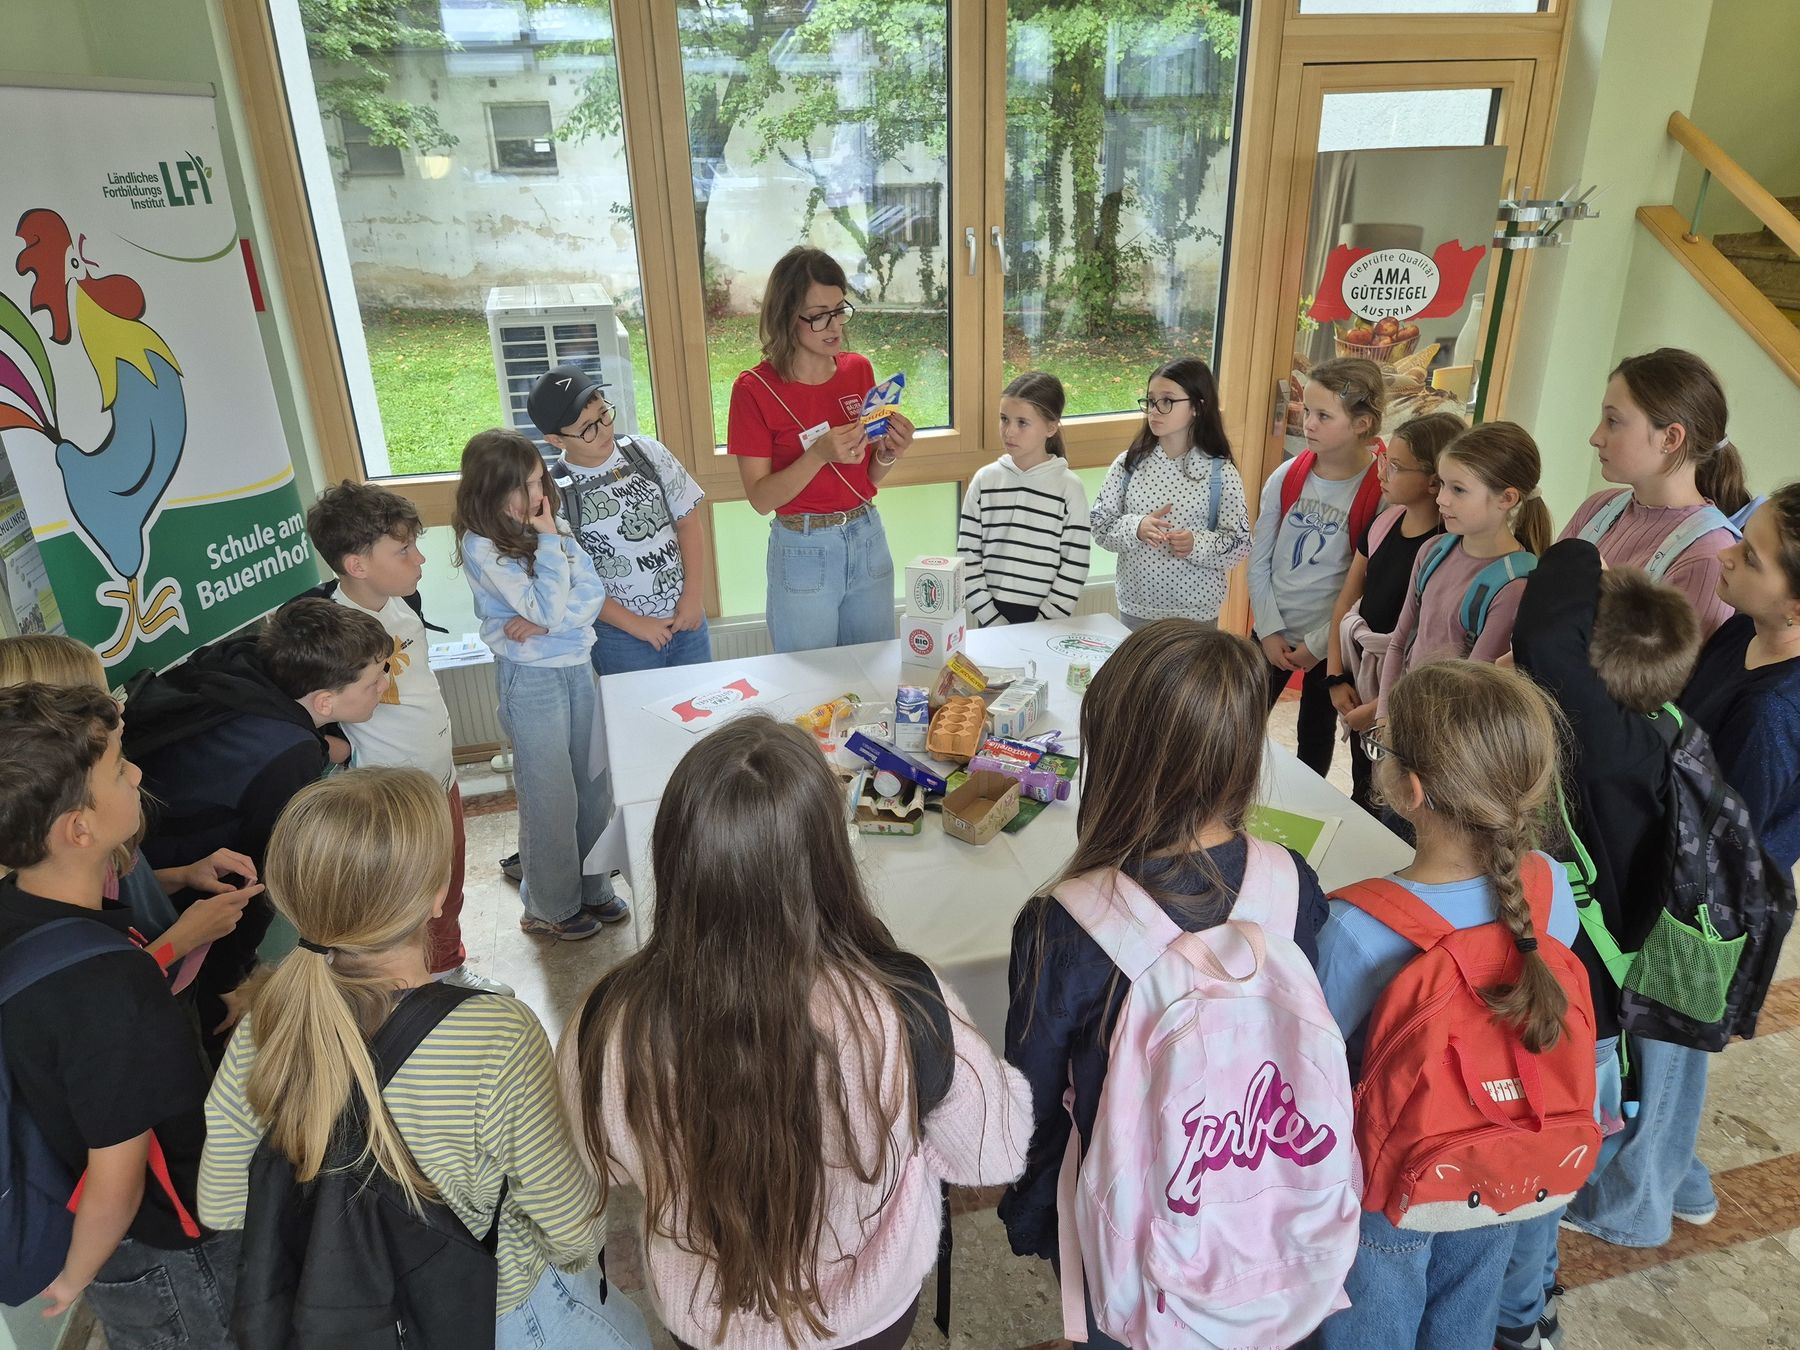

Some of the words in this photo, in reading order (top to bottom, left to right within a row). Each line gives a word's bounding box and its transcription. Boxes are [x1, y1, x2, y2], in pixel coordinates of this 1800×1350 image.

[106, 171, 160, 185] Ländliches
[158, 150, 213, 207] LFI
[102, 185, 163, 198] Fortbildungs
[130, 198, 166, 210] Institut
[1349, 252, 1395, 280] Geprüfte
[1398, 252, 1435, 279] Qualität
[1372, 267, 1411, 285] AMA
[1350, 283, 1428, 301] GÜTESIEGEL
[1360, 304, 1413, 317] AUSTRIA
[206, 523, 276, 570] Schule
[277, 512, 304, 539] am
[195, 531, 310, 610] Bauernhof
[914, 637, 928, 646] BIO
